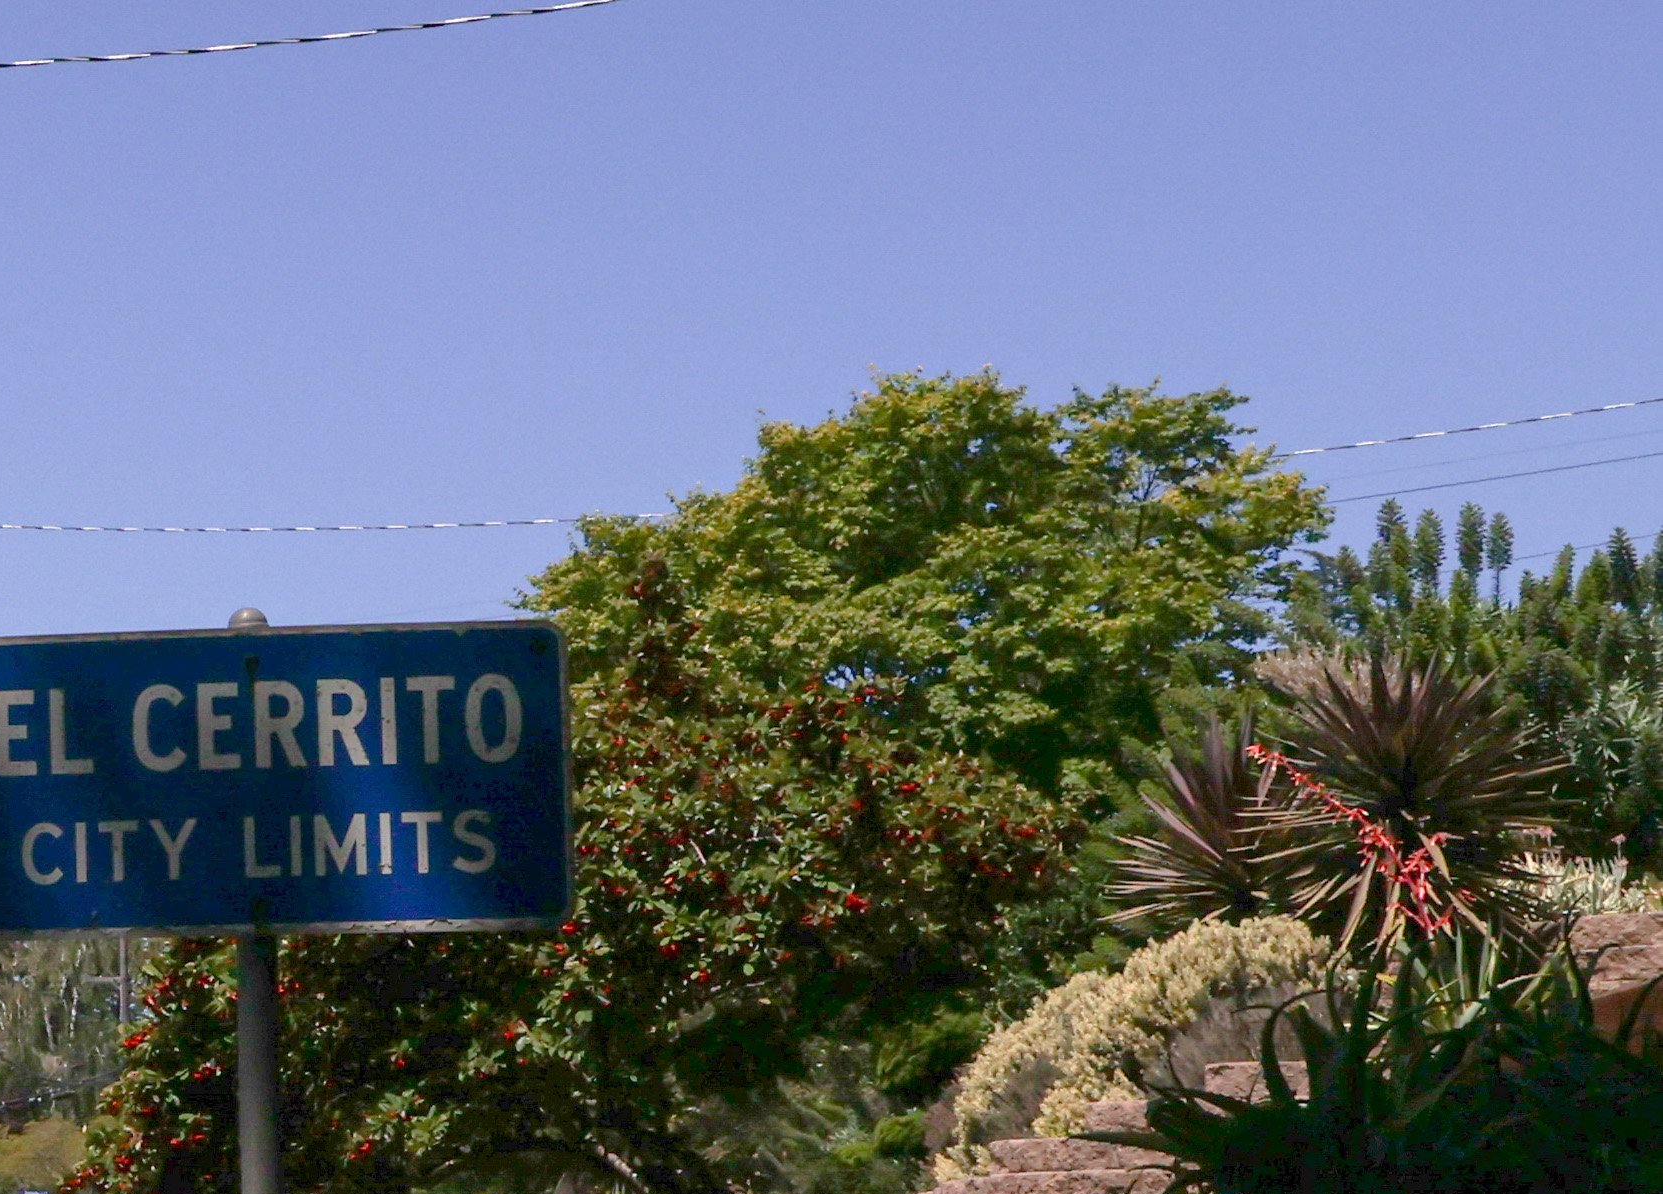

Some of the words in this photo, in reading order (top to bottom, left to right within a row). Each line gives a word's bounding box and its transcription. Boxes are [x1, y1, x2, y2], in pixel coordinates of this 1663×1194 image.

[131, 673, 524, 773] CERRITO
[20, 817, 198, 886] CITY
[242, 809, 498, 880] LIMITS
